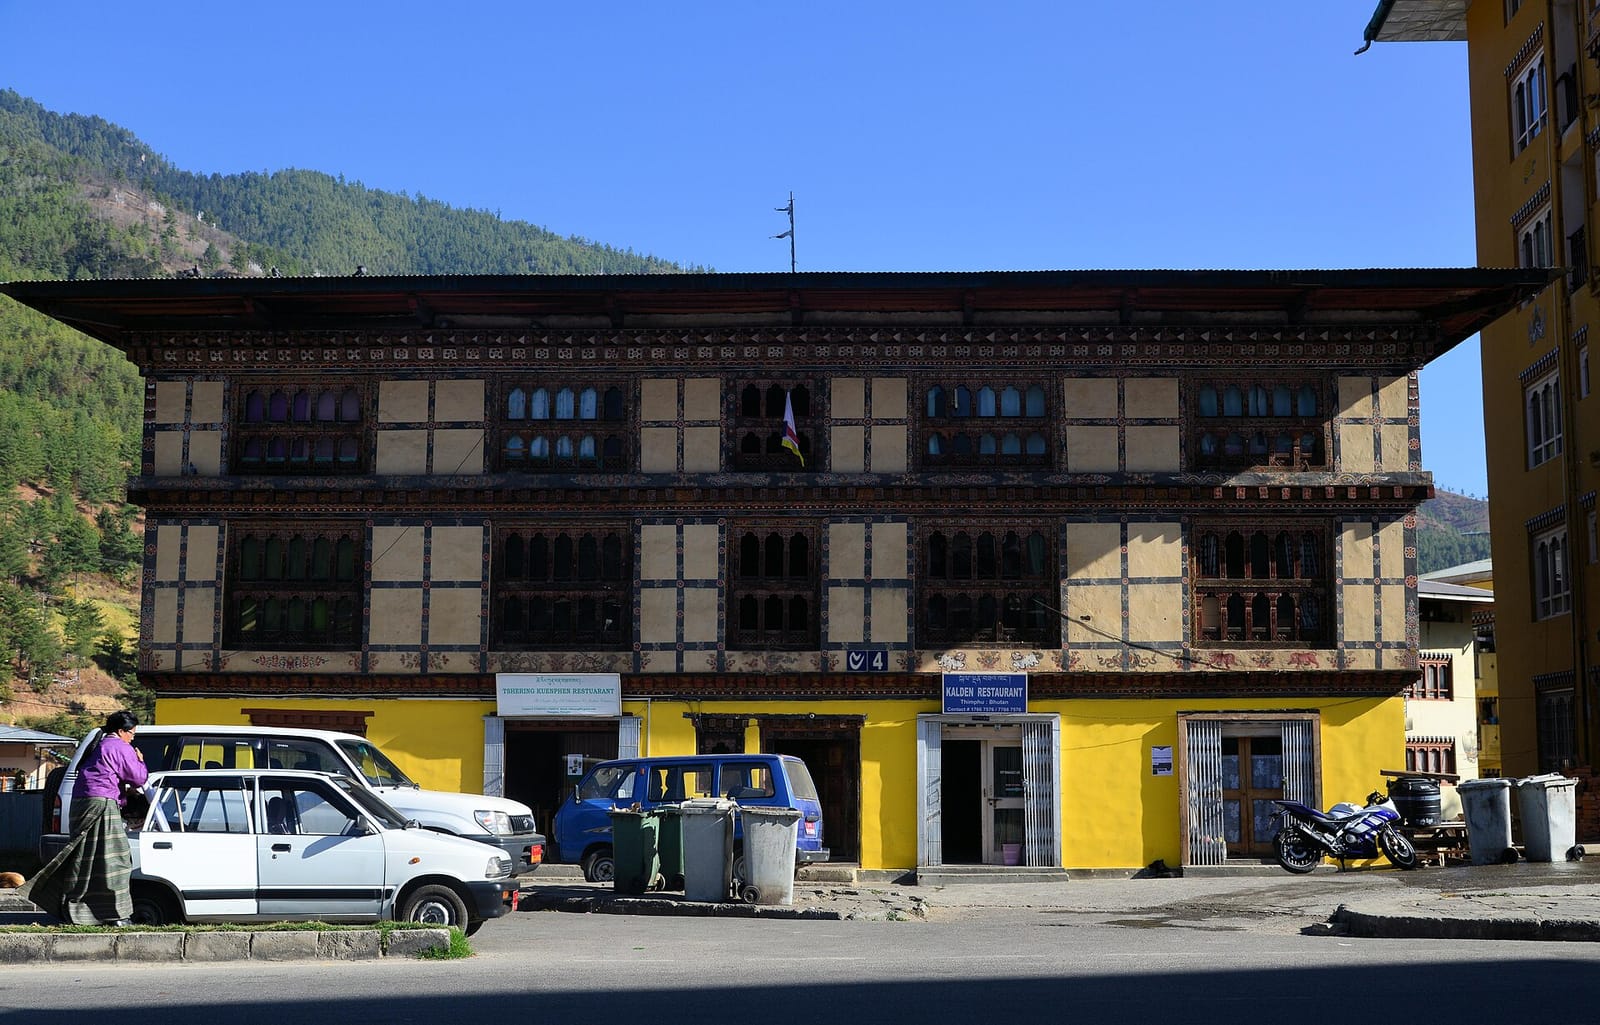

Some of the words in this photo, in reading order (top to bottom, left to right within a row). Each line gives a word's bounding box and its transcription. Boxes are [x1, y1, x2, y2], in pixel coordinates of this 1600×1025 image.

[872, 651, 884, 671] 4
[502, 687, 535, 695] TSHERING
[536, 687, 571, 695] KUENPHEN
[572, 687, 615, 695] RESTUARANT
[945, 686, 974, 697] KALDEN
[977, 687, 1024, 697] RESTAURANT
